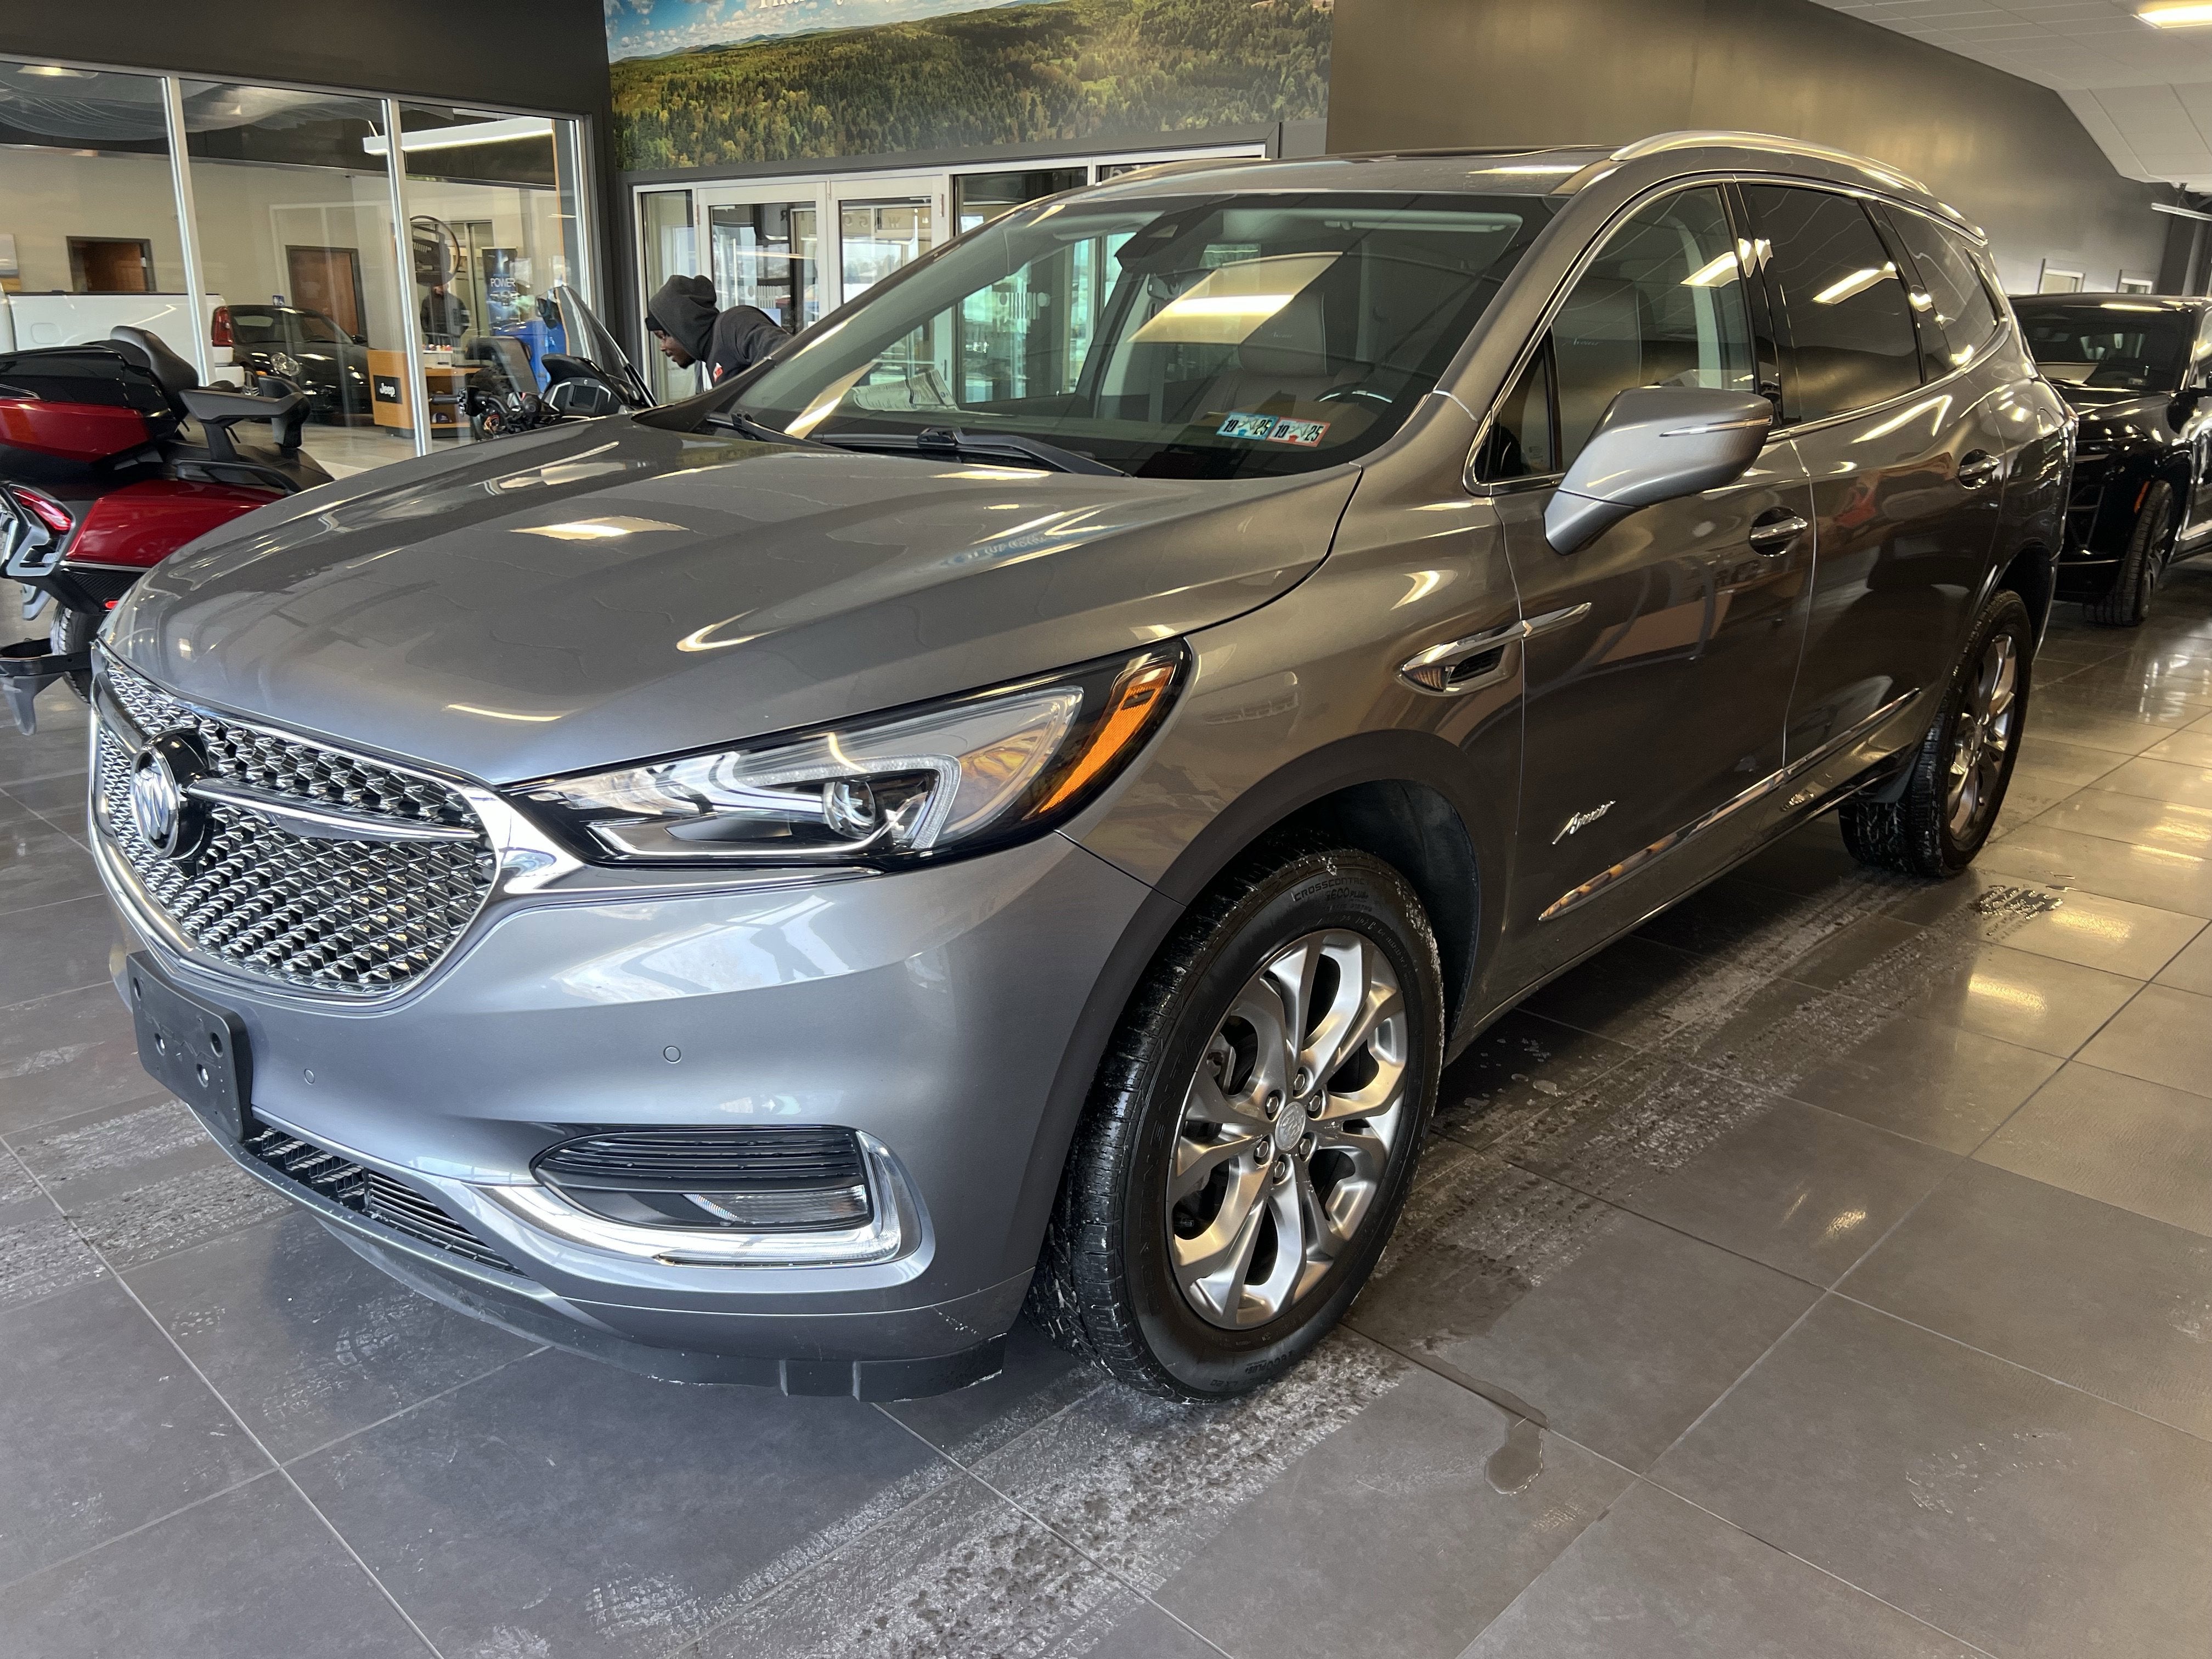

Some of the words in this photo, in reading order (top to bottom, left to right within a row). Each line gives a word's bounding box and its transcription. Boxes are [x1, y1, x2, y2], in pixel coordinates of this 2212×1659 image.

[490, 278, 516, 287] POWER
[379, 382, 396, 397] Jeep
[1253, 419, 1273, 436] 25
[1305, 425, 1324, 442] 25
